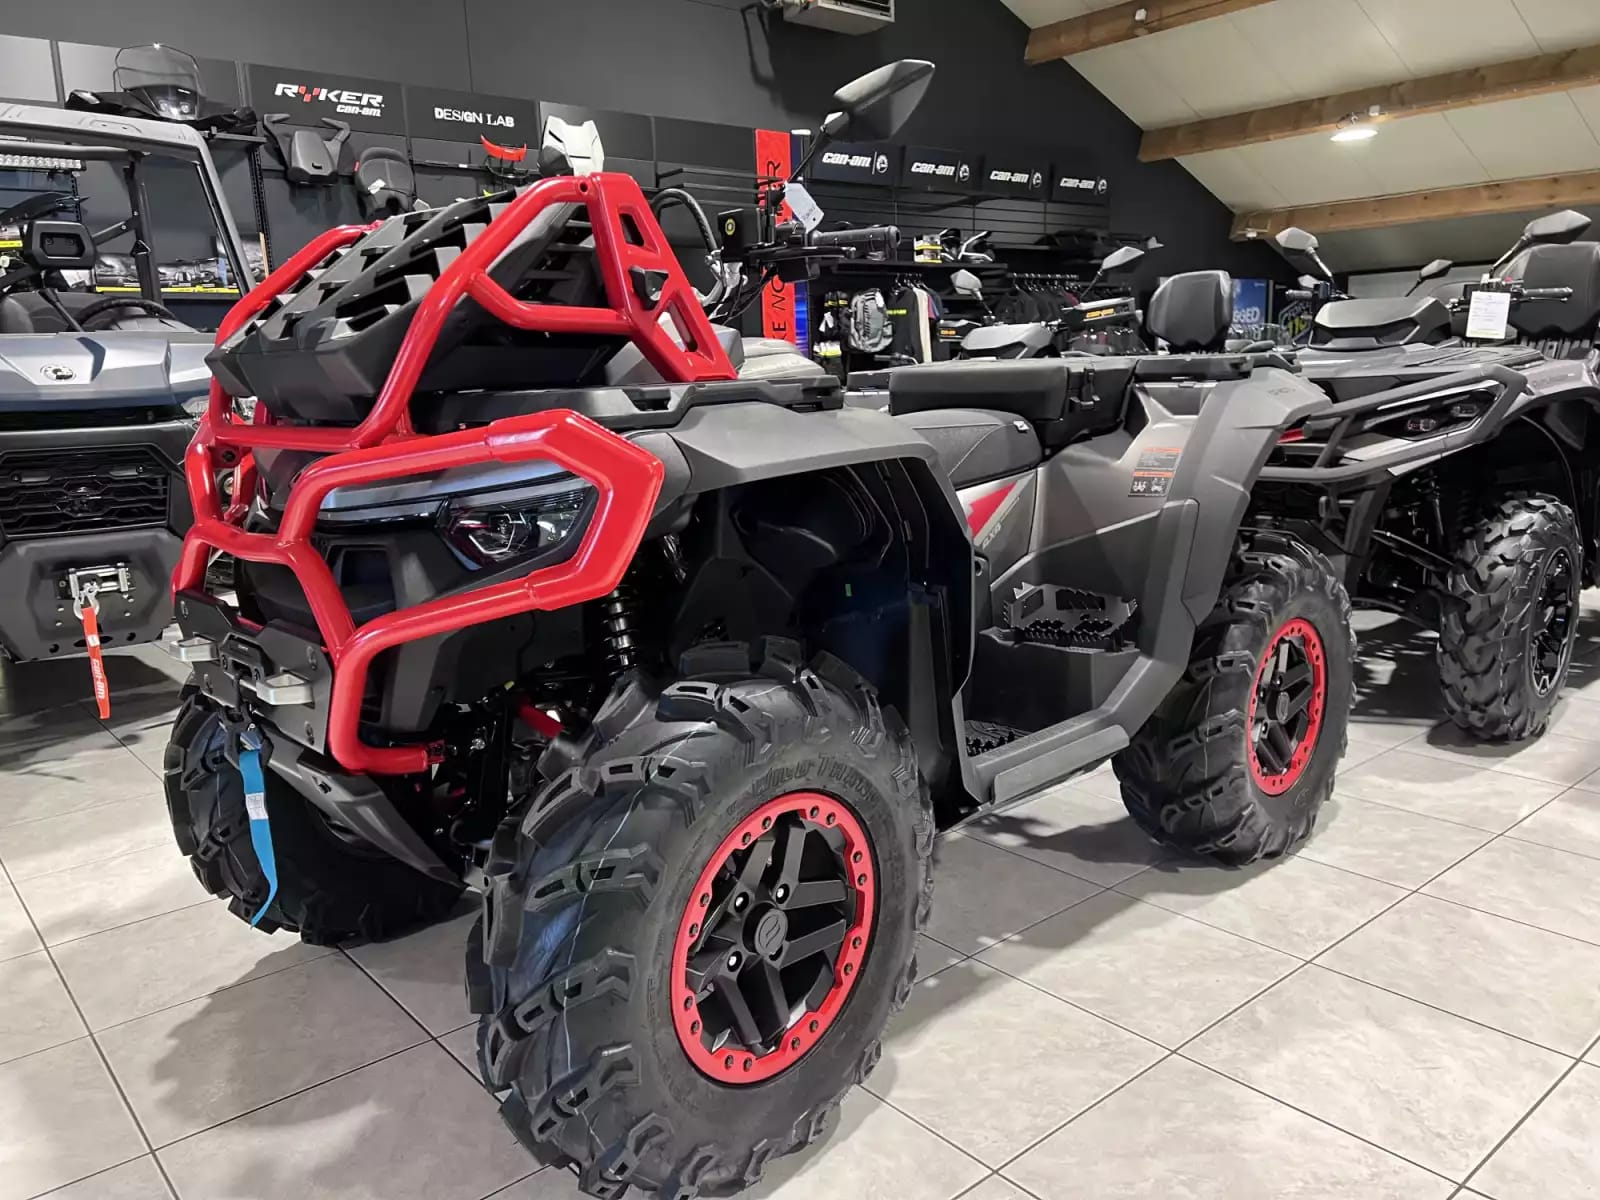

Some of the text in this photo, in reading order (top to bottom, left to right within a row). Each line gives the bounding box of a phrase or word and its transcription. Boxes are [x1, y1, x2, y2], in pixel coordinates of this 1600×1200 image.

[274, 82, 384, 107] RYKER
[336, 103, 382, 117] can-am
[434, 107, 515, 128] DESIGN LAB
[822, 151, 871, 168] can-am
[911, 161, 955, 176] can-am
[989, 169, 1029, 184] can-am
[1059, 176, 1096, 190] can-am
[92, 658, 106, 700] can-am
